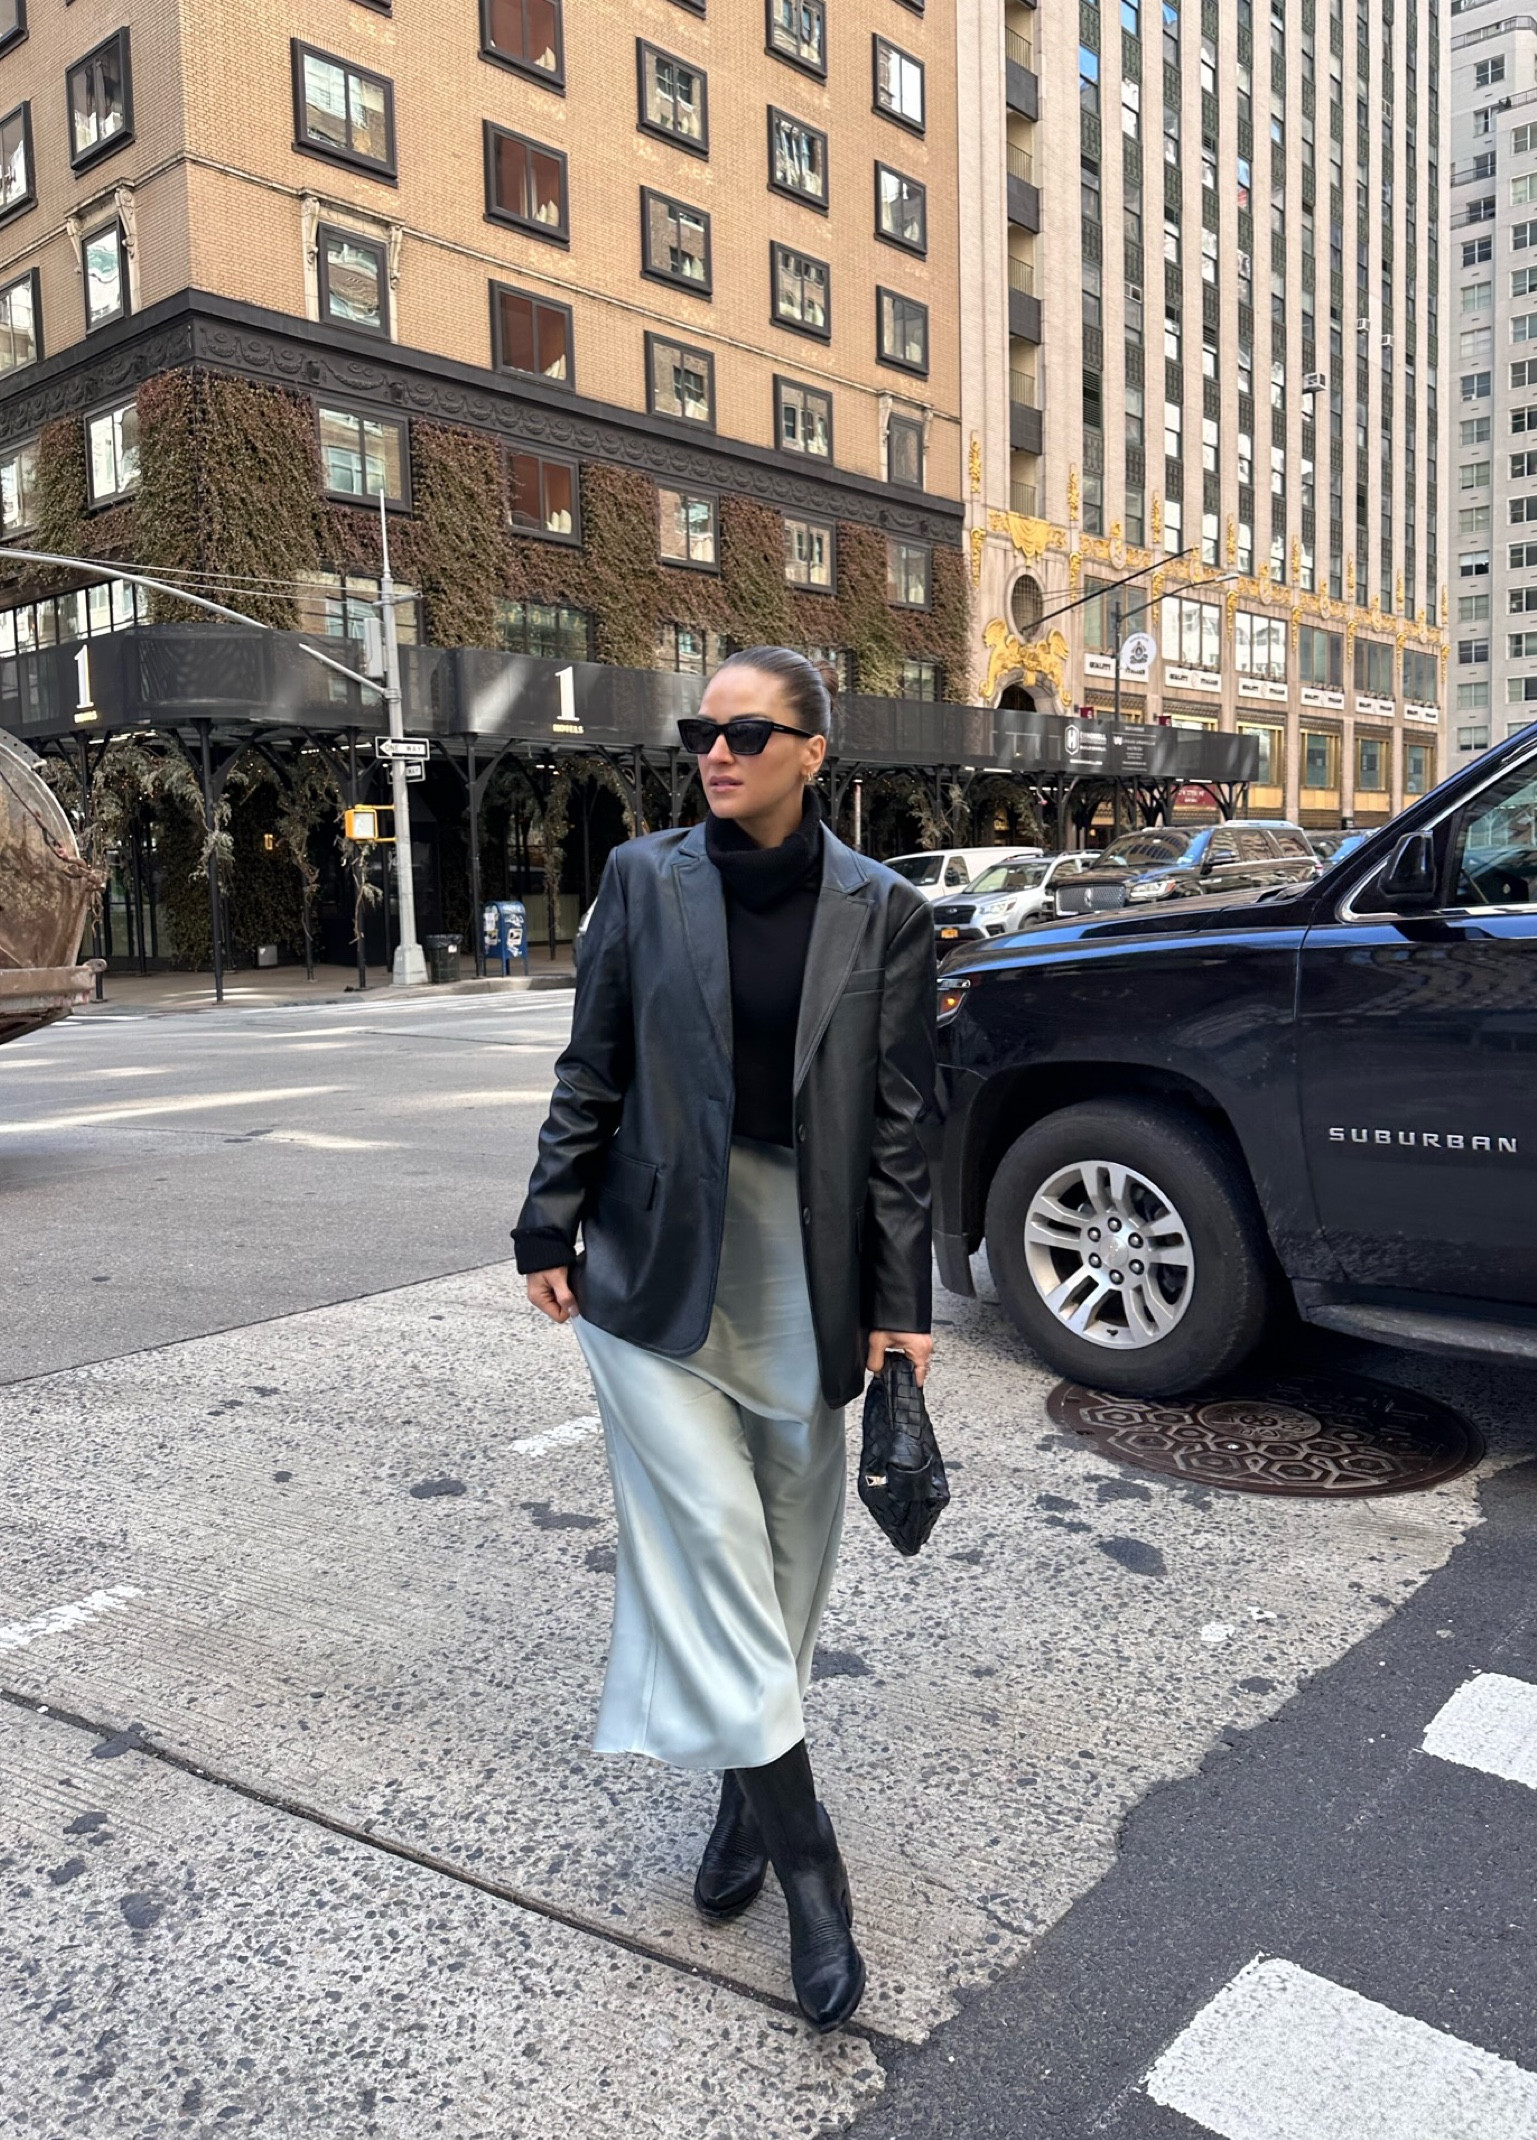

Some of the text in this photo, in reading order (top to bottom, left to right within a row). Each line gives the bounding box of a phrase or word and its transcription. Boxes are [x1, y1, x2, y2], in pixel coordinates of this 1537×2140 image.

[74, 644, 95, 709] 1
[554, 665, 580, 722] 1
[552, 723, 584, 735] HOTELS
[384, 743, 399, 752] ONE
[1328, 1127, 1518, 1153] SUBURBAN
